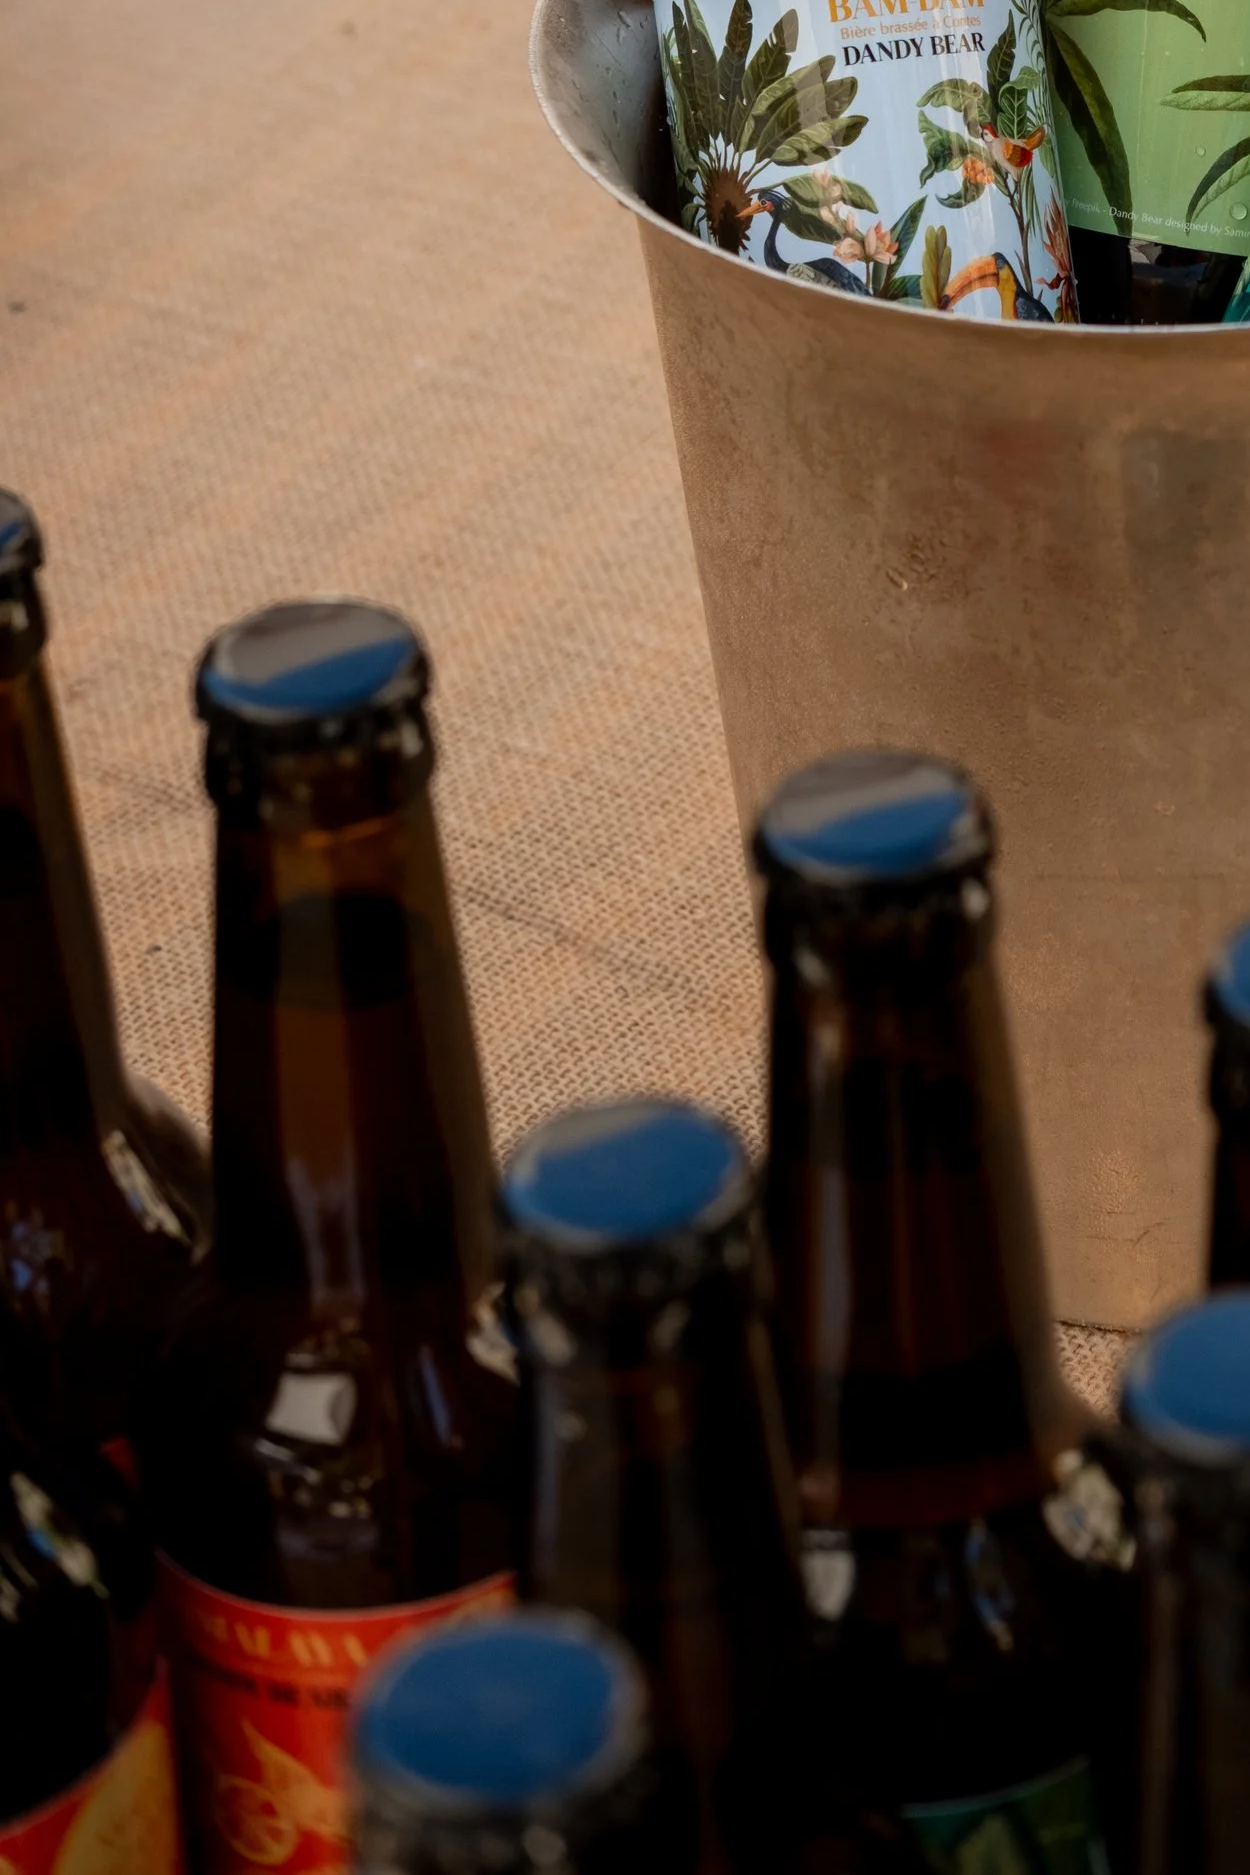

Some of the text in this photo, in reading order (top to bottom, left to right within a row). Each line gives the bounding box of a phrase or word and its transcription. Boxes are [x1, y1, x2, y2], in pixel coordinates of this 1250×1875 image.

[840, 15, 982, 40] Bière brassée à Contes
[842, 32, 986, 66] DANDY BEAR
[1109, 206, 1139, 221] Dandy
[1141, 212, 1164, 225] Bear
[1165, 217, 1208, 233] designed
[1210, 223, 1222, 237] by
